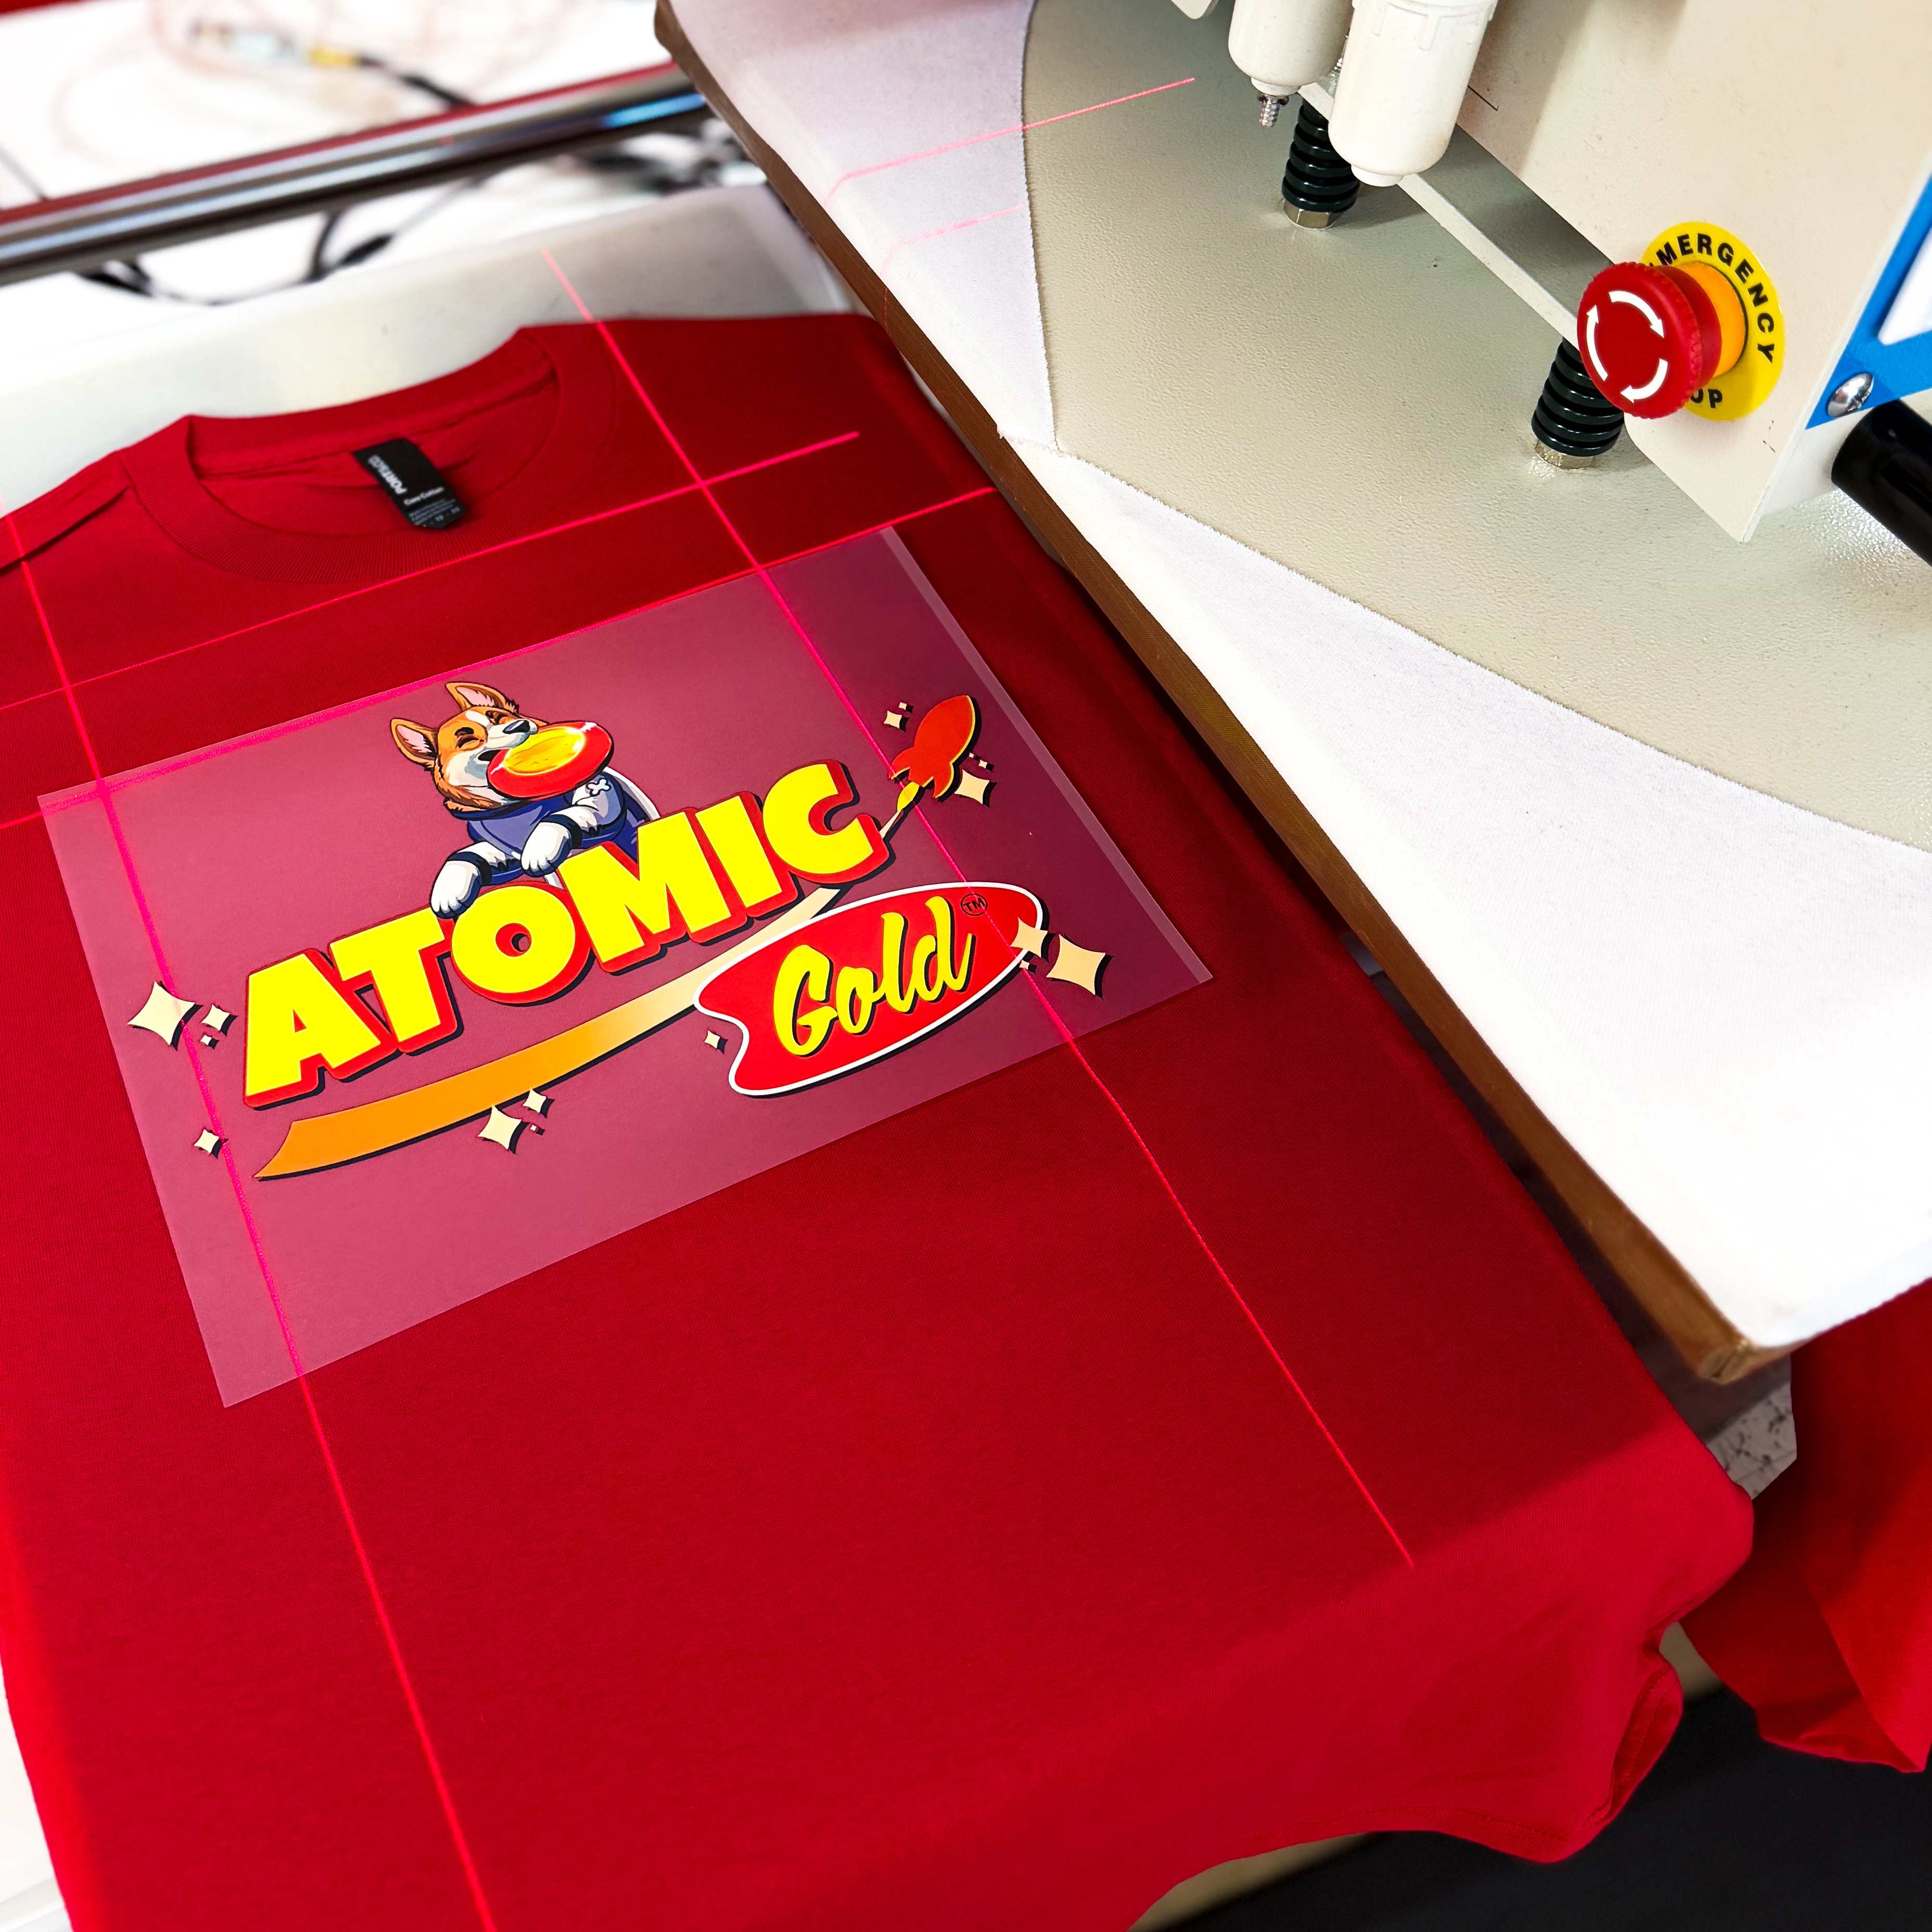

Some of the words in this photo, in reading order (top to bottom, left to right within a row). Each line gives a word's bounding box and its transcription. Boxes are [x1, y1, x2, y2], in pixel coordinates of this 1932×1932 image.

[1649, 233, 1775, 364] MERGENCY
[1690, 388, 1723, 409] OP
[404, 495, 421, 505] Core
[420, 487, 444, 499] Cotton
[246, 762, 880, 1101] ATOMIC
[772, 896, 973, 1058] Gold
[962, 896, 986, 912] TM
